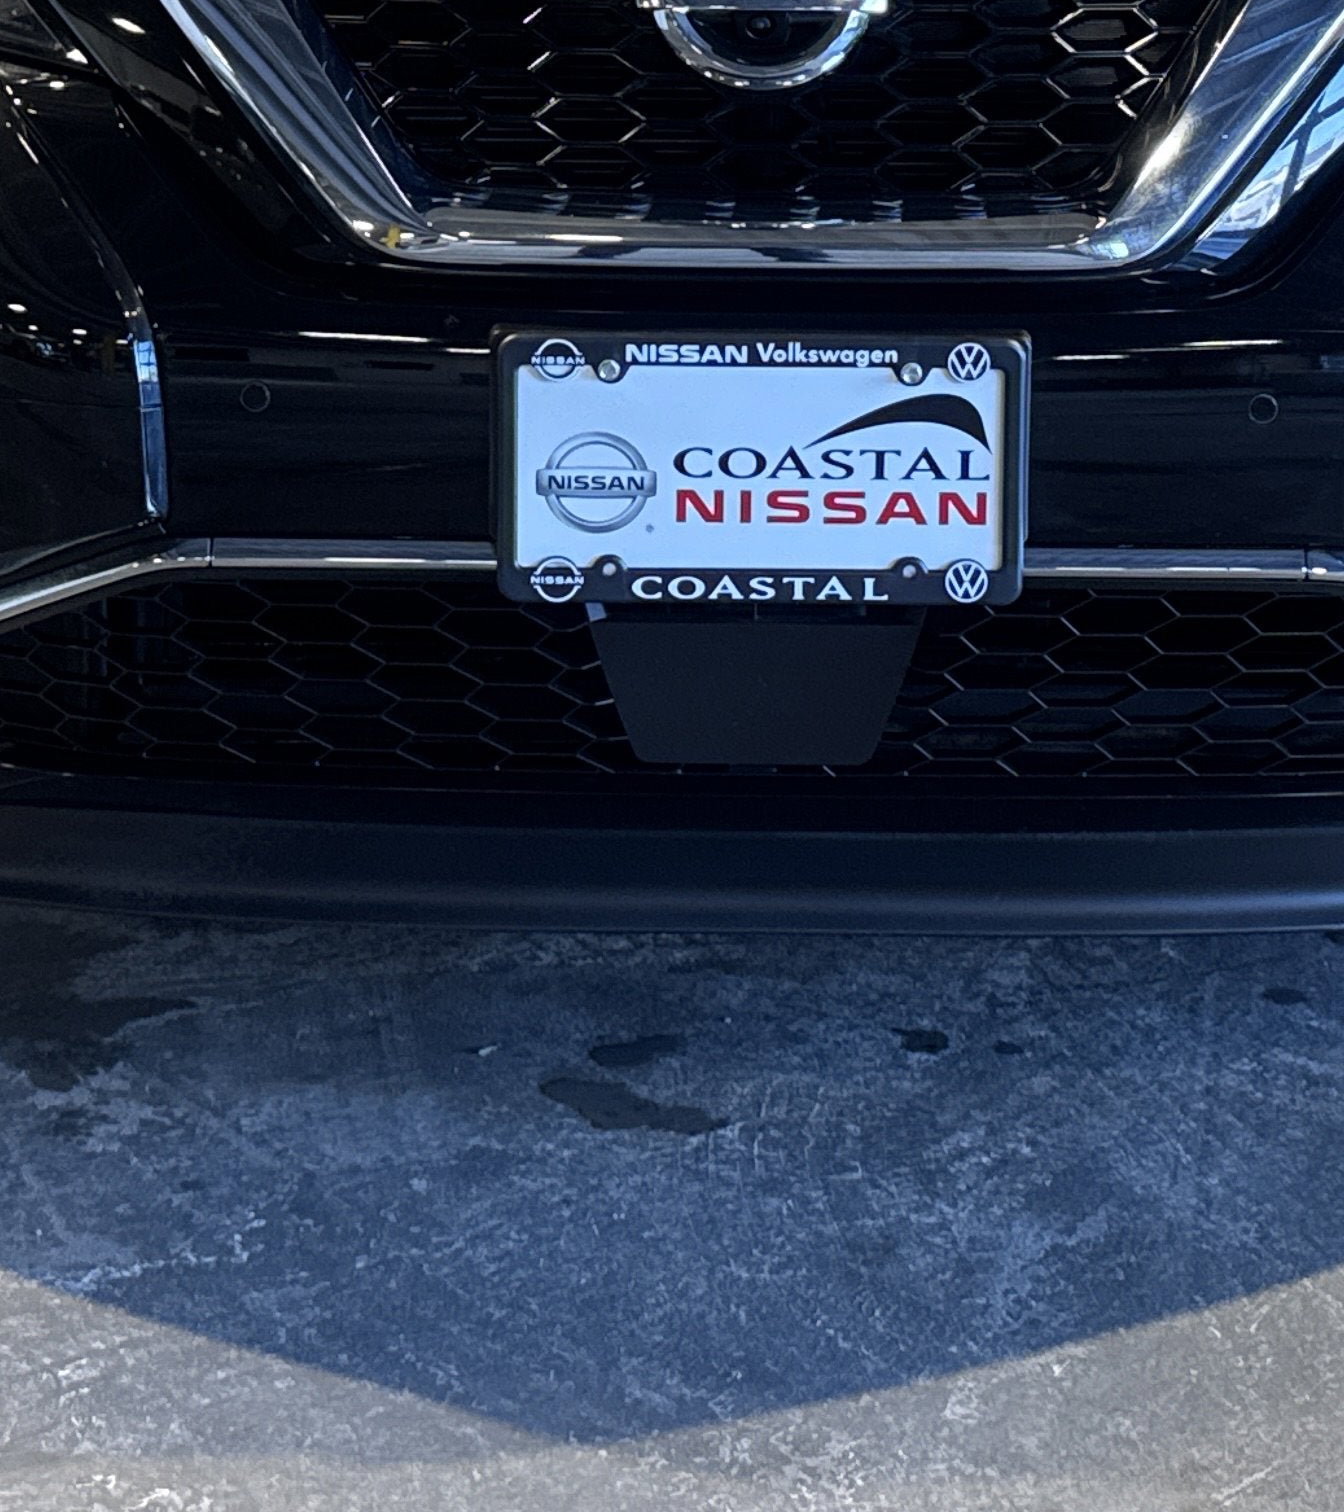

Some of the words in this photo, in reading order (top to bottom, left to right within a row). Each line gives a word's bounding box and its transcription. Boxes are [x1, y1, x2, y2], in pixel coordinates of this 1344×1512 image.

[531, 355, 585, 365] NISSAN
[625, 343, 748, 364] NISSAN
[756, 342, 898, 368] Volkswagen
[673, 445, 991, 481] COASTAL
[547, 473, 646, 491] NISSAN
[675, 489, 988, 526] NISSAN
[530, 575, 584, 585] NISSAN
[631, 575, 889, 600] COASTAL
